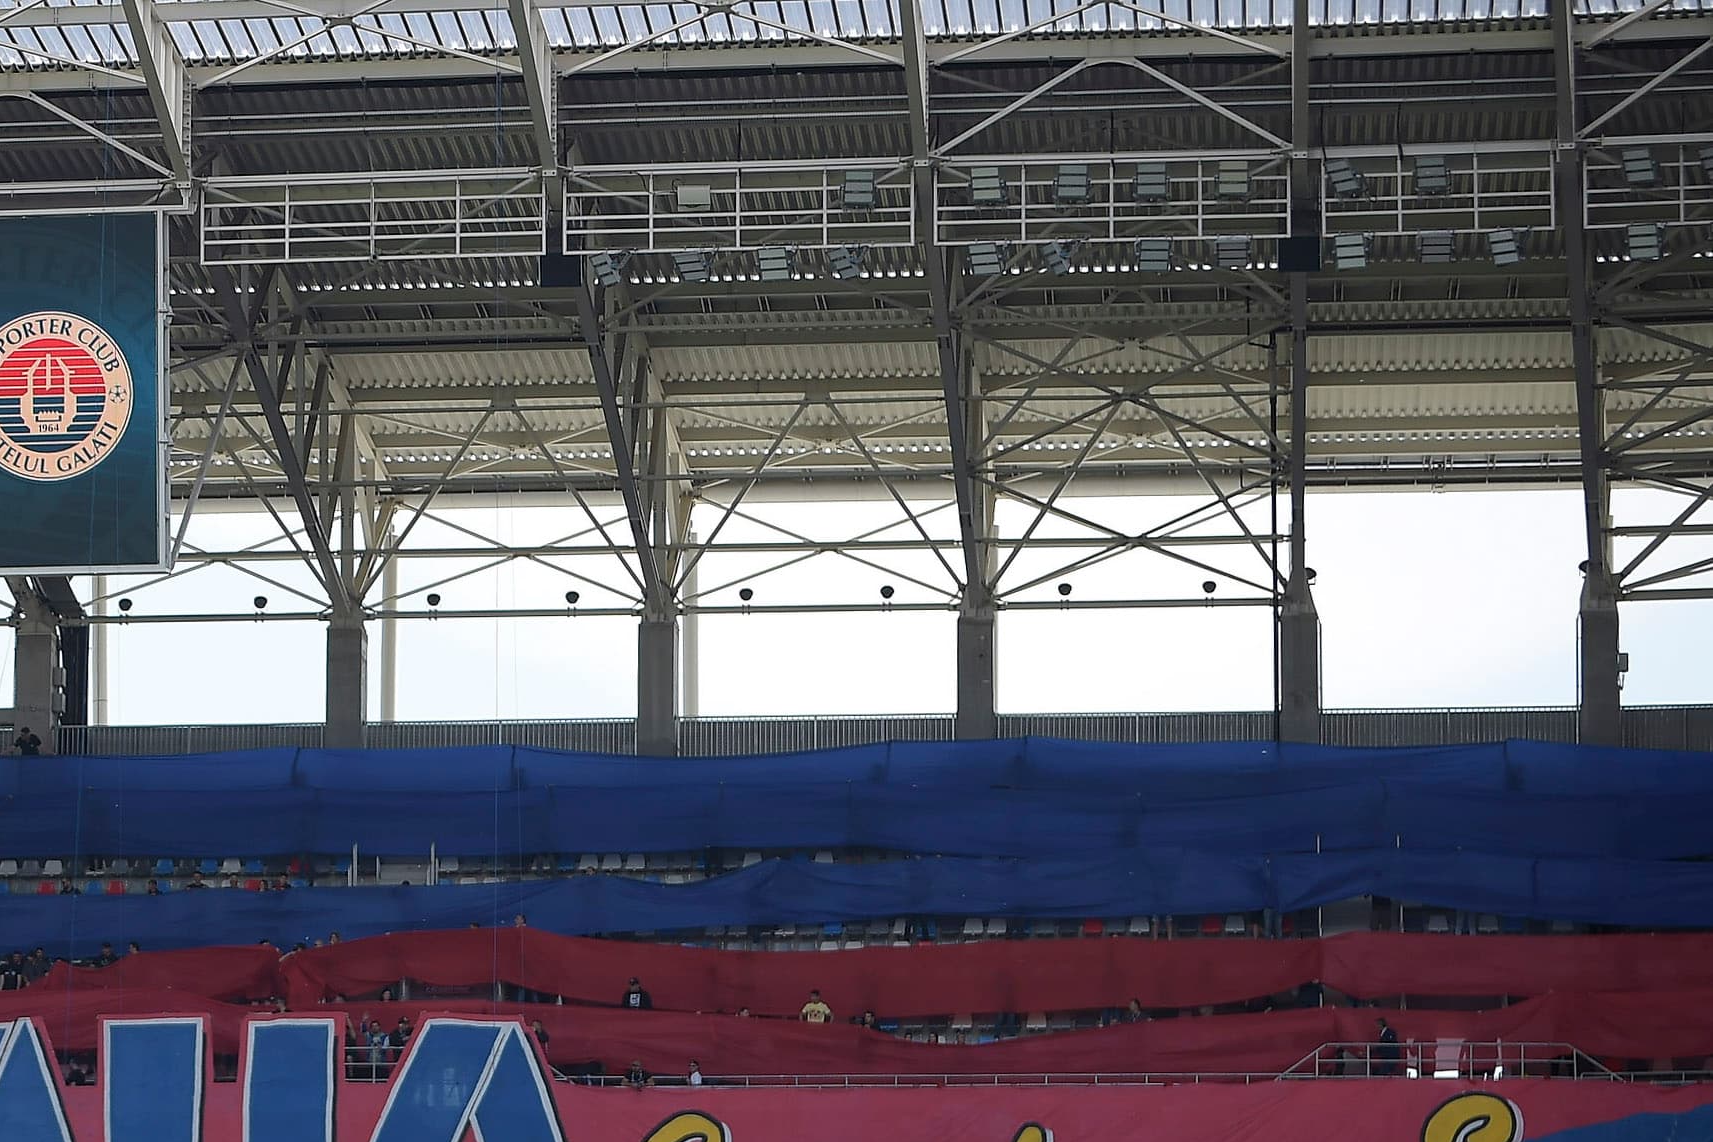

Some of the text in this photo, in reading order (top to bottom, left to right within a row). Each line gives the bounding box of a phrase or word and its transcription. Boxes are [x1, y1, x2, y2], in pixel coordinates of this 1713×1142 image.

[78, 328, 120, 373] CLUB
[38, 424, 60, 433] 1964
[57, 421, 118, 472] GALATI
